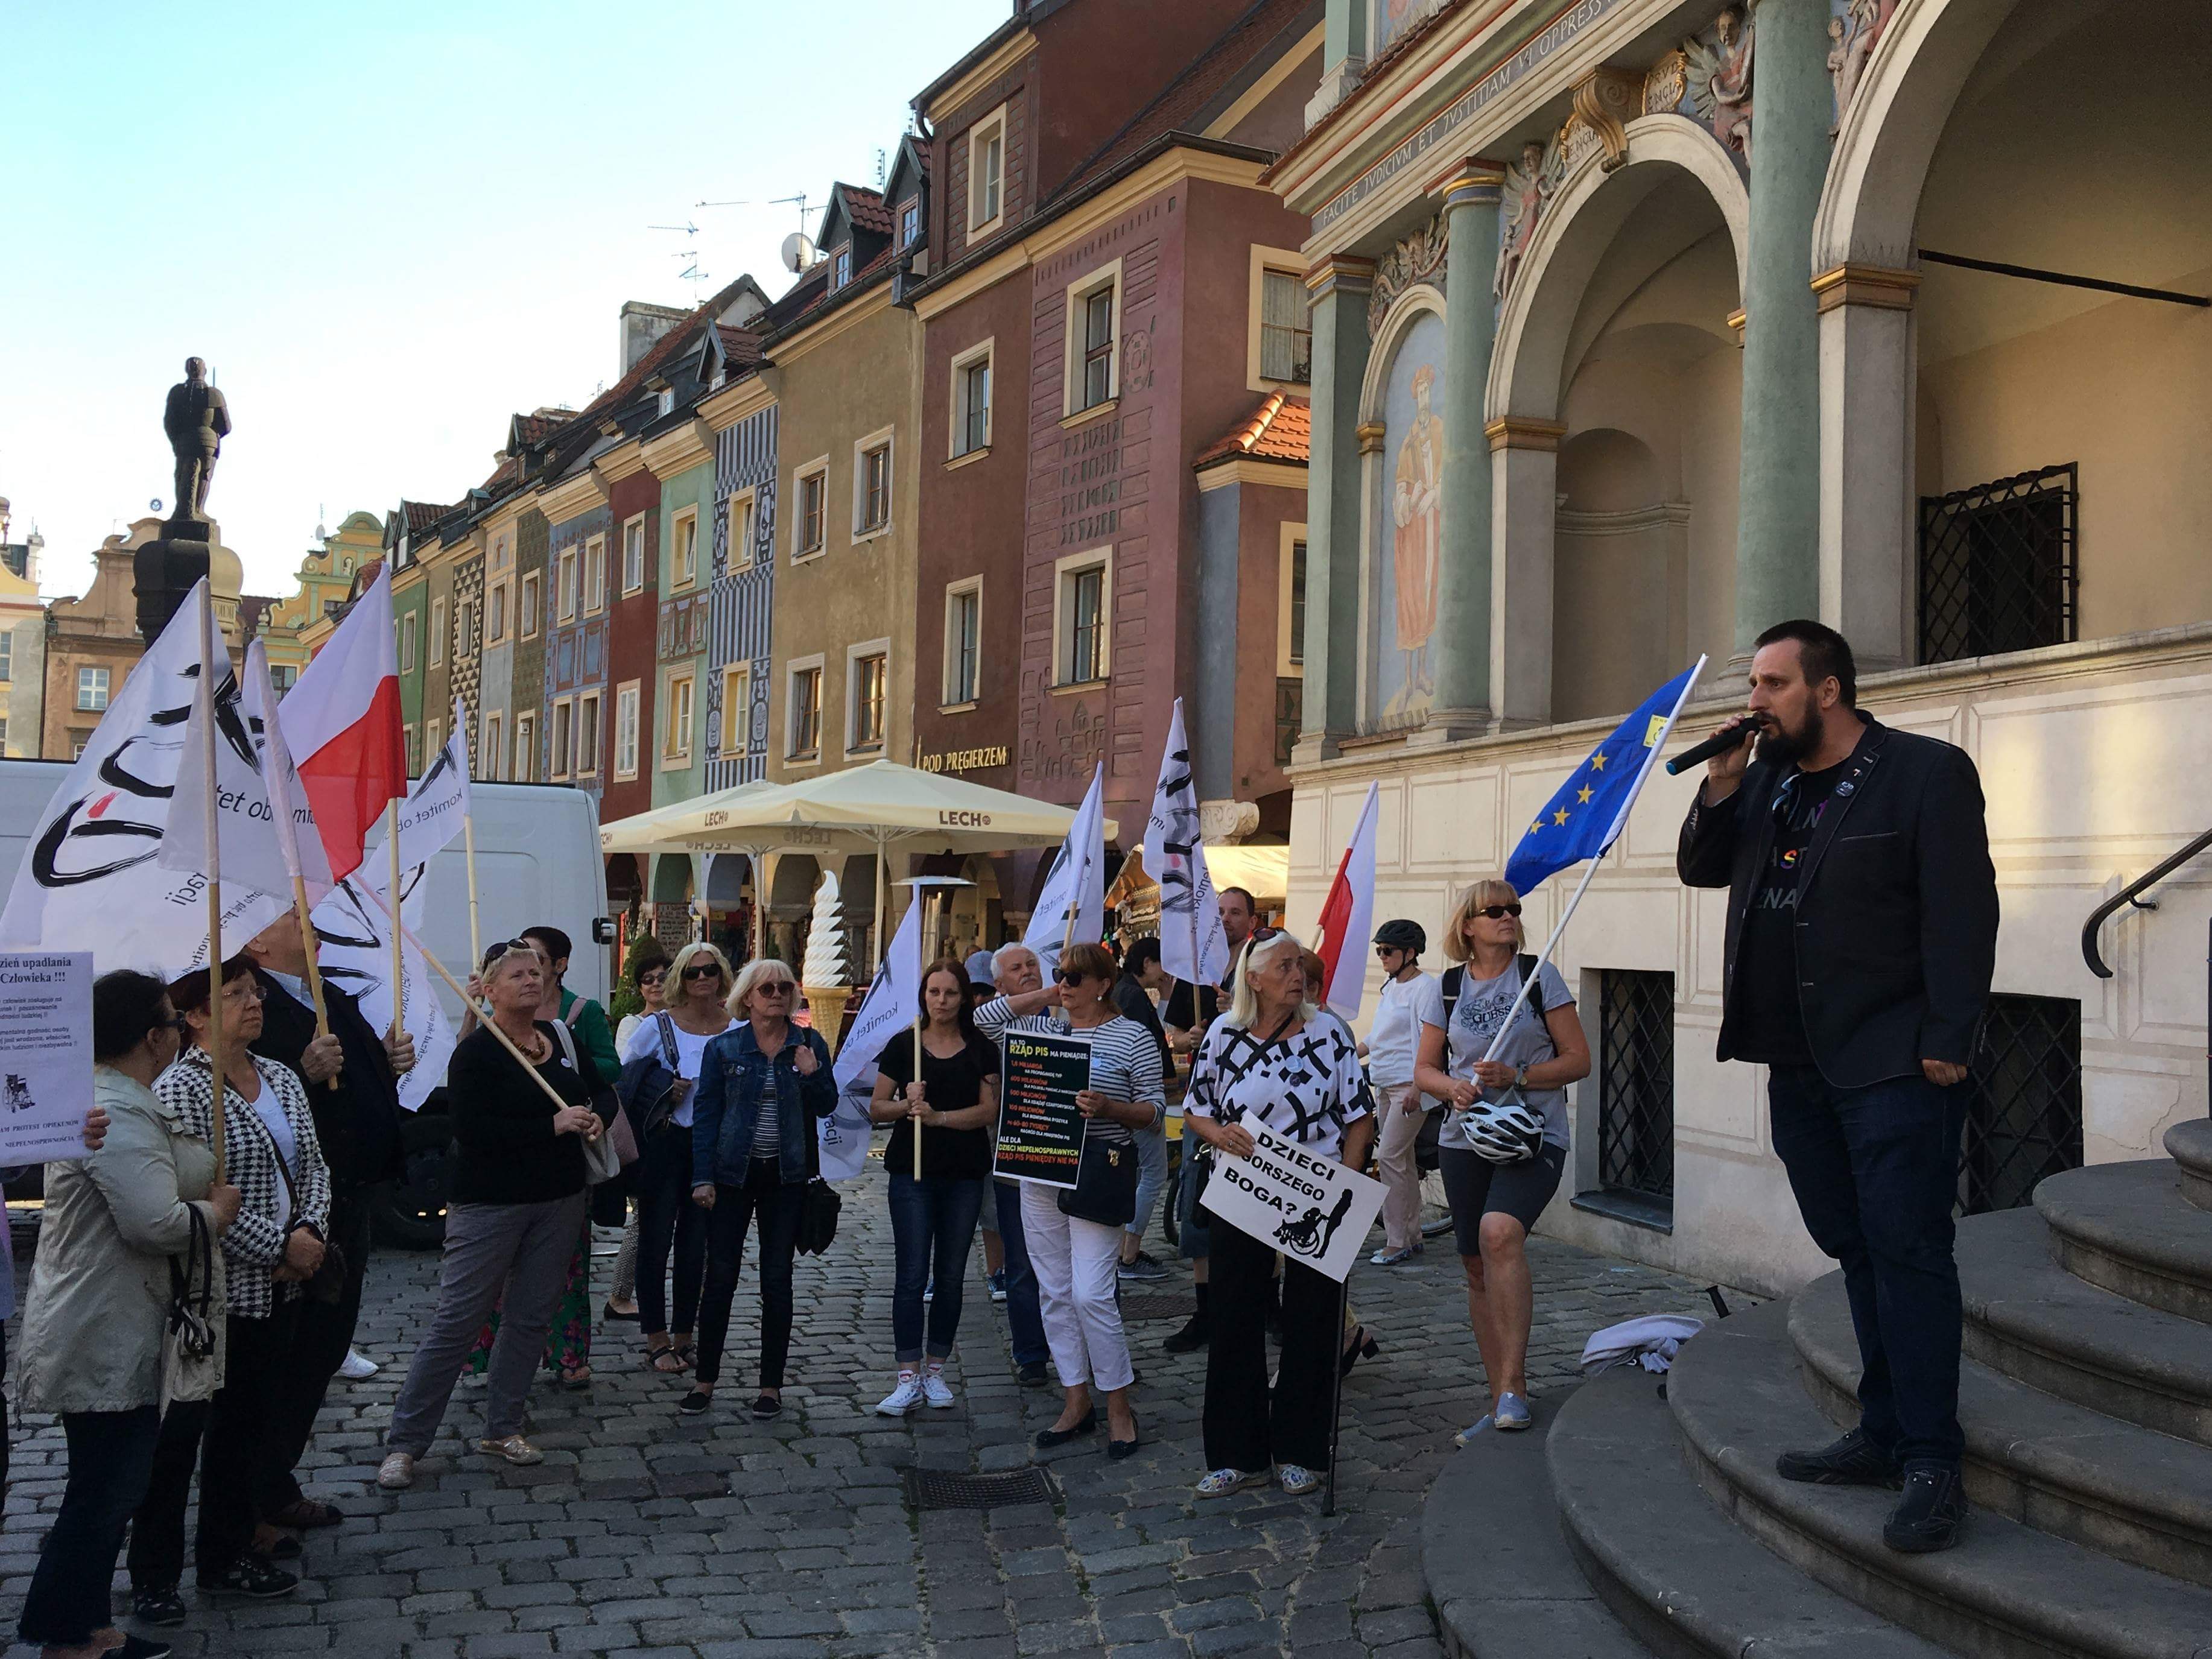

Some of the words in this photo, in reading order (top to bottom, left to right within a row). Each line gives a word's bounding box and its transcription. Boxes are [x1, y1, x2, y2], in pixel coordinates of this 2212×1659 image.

[1323, 186, 1358, 226] FACITE
[1419, 124, 1436, 151] ET
[1539, 0, 1611, 55] OPPRESS
[924, 754, 942, 773] POD
[946, 746, 1007, 775] PRĘGIERZEM
[705, 811, 724, 827] LECH
[939, 811, 981, 826] LECH
[1, 972, 51, 984] Człowieka
[54, 972, 66, 982] !!!
[1473, 1005, 1511, 1023] GUESS
[1010, 1045, 1033, 1057] RZĄD
[1035, 1046, 1048, 1056] PIS
[13, 1123, 39, 1132] PROTEST
[998, 1152, 1014, 1161] RZĄD
[1025, 1154, 1056, 1164] PIENIĘDZY
[1257, 1132, 1336, 1181] DZIECI
[1224, 1166, 1298, 1216] BOGA?
